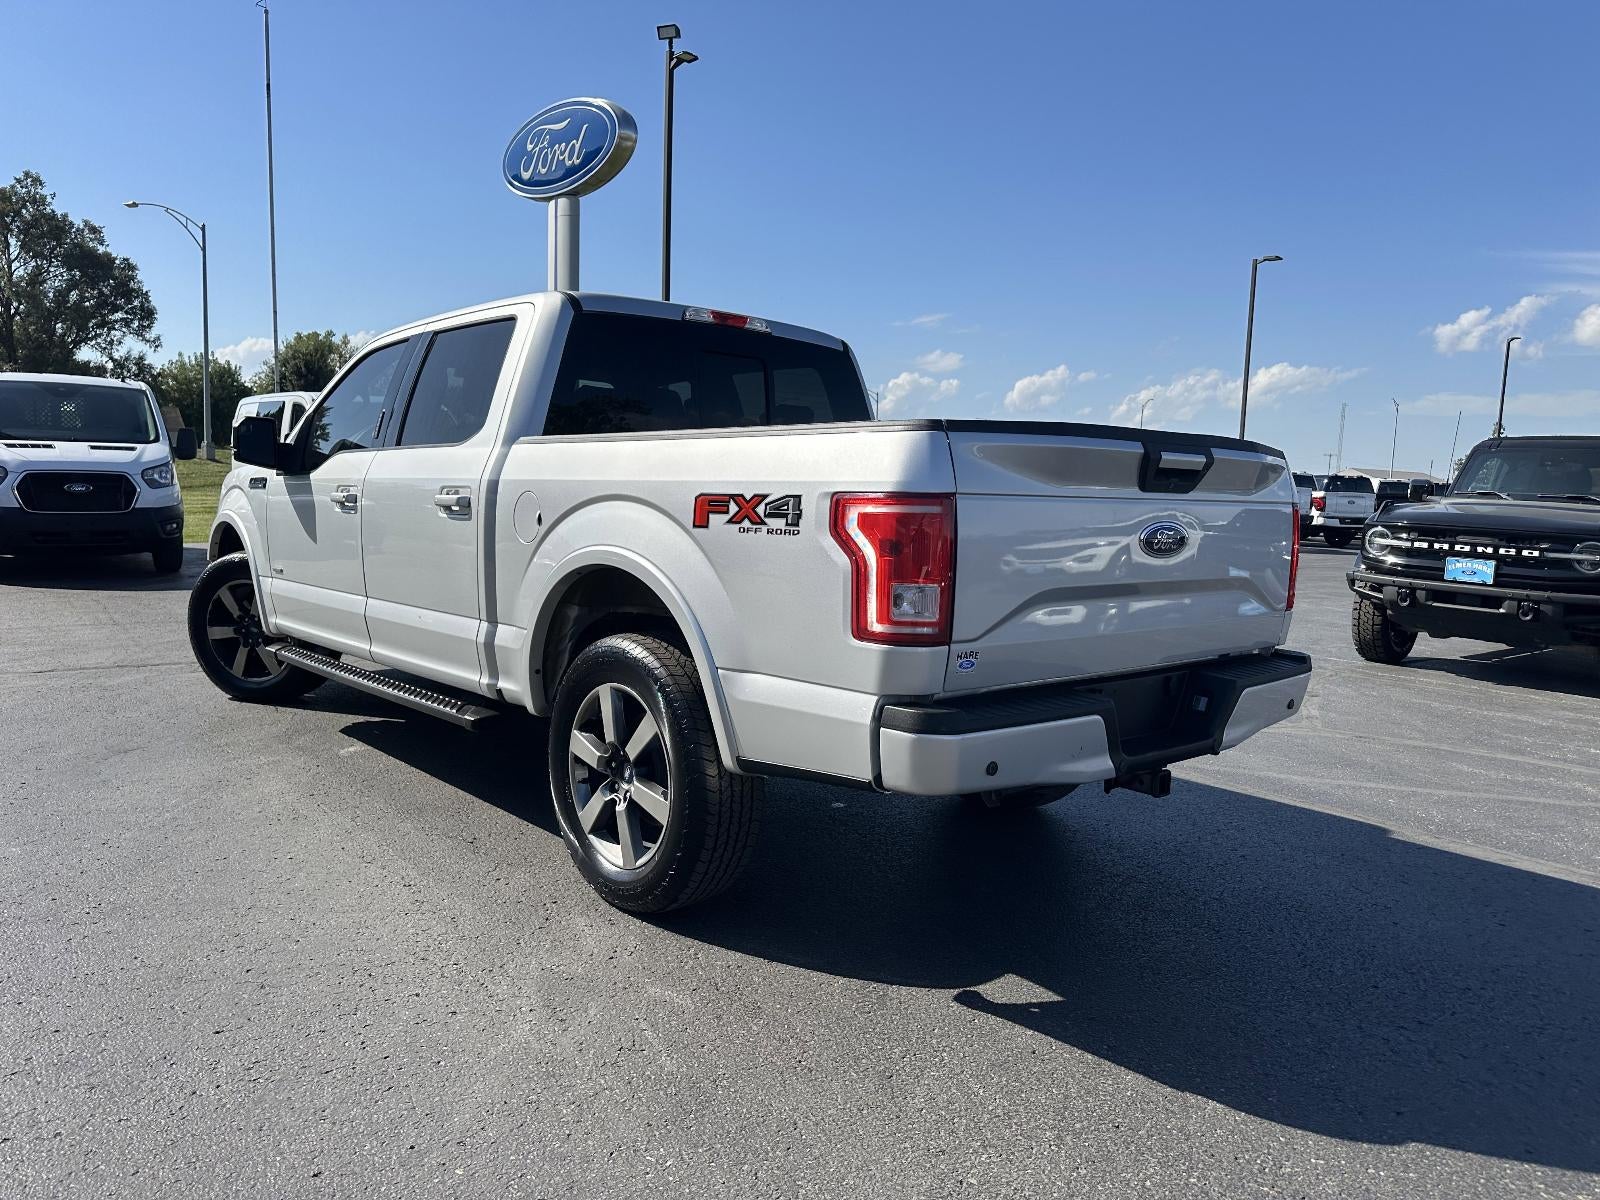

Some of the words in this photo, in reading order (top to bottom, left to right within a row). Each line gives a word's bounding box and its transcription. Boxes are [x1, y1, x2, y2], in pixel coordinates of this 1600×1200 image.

[520, 118, 589, 180] Ford
[693, 493, 803, 529] FX4
[738, 526, 762, 535] OFF
[766, 527, 801, 536] ROAD
[1413, 541, 1540, 557] BRONCO
[956, 650, 980, 661] HARE
